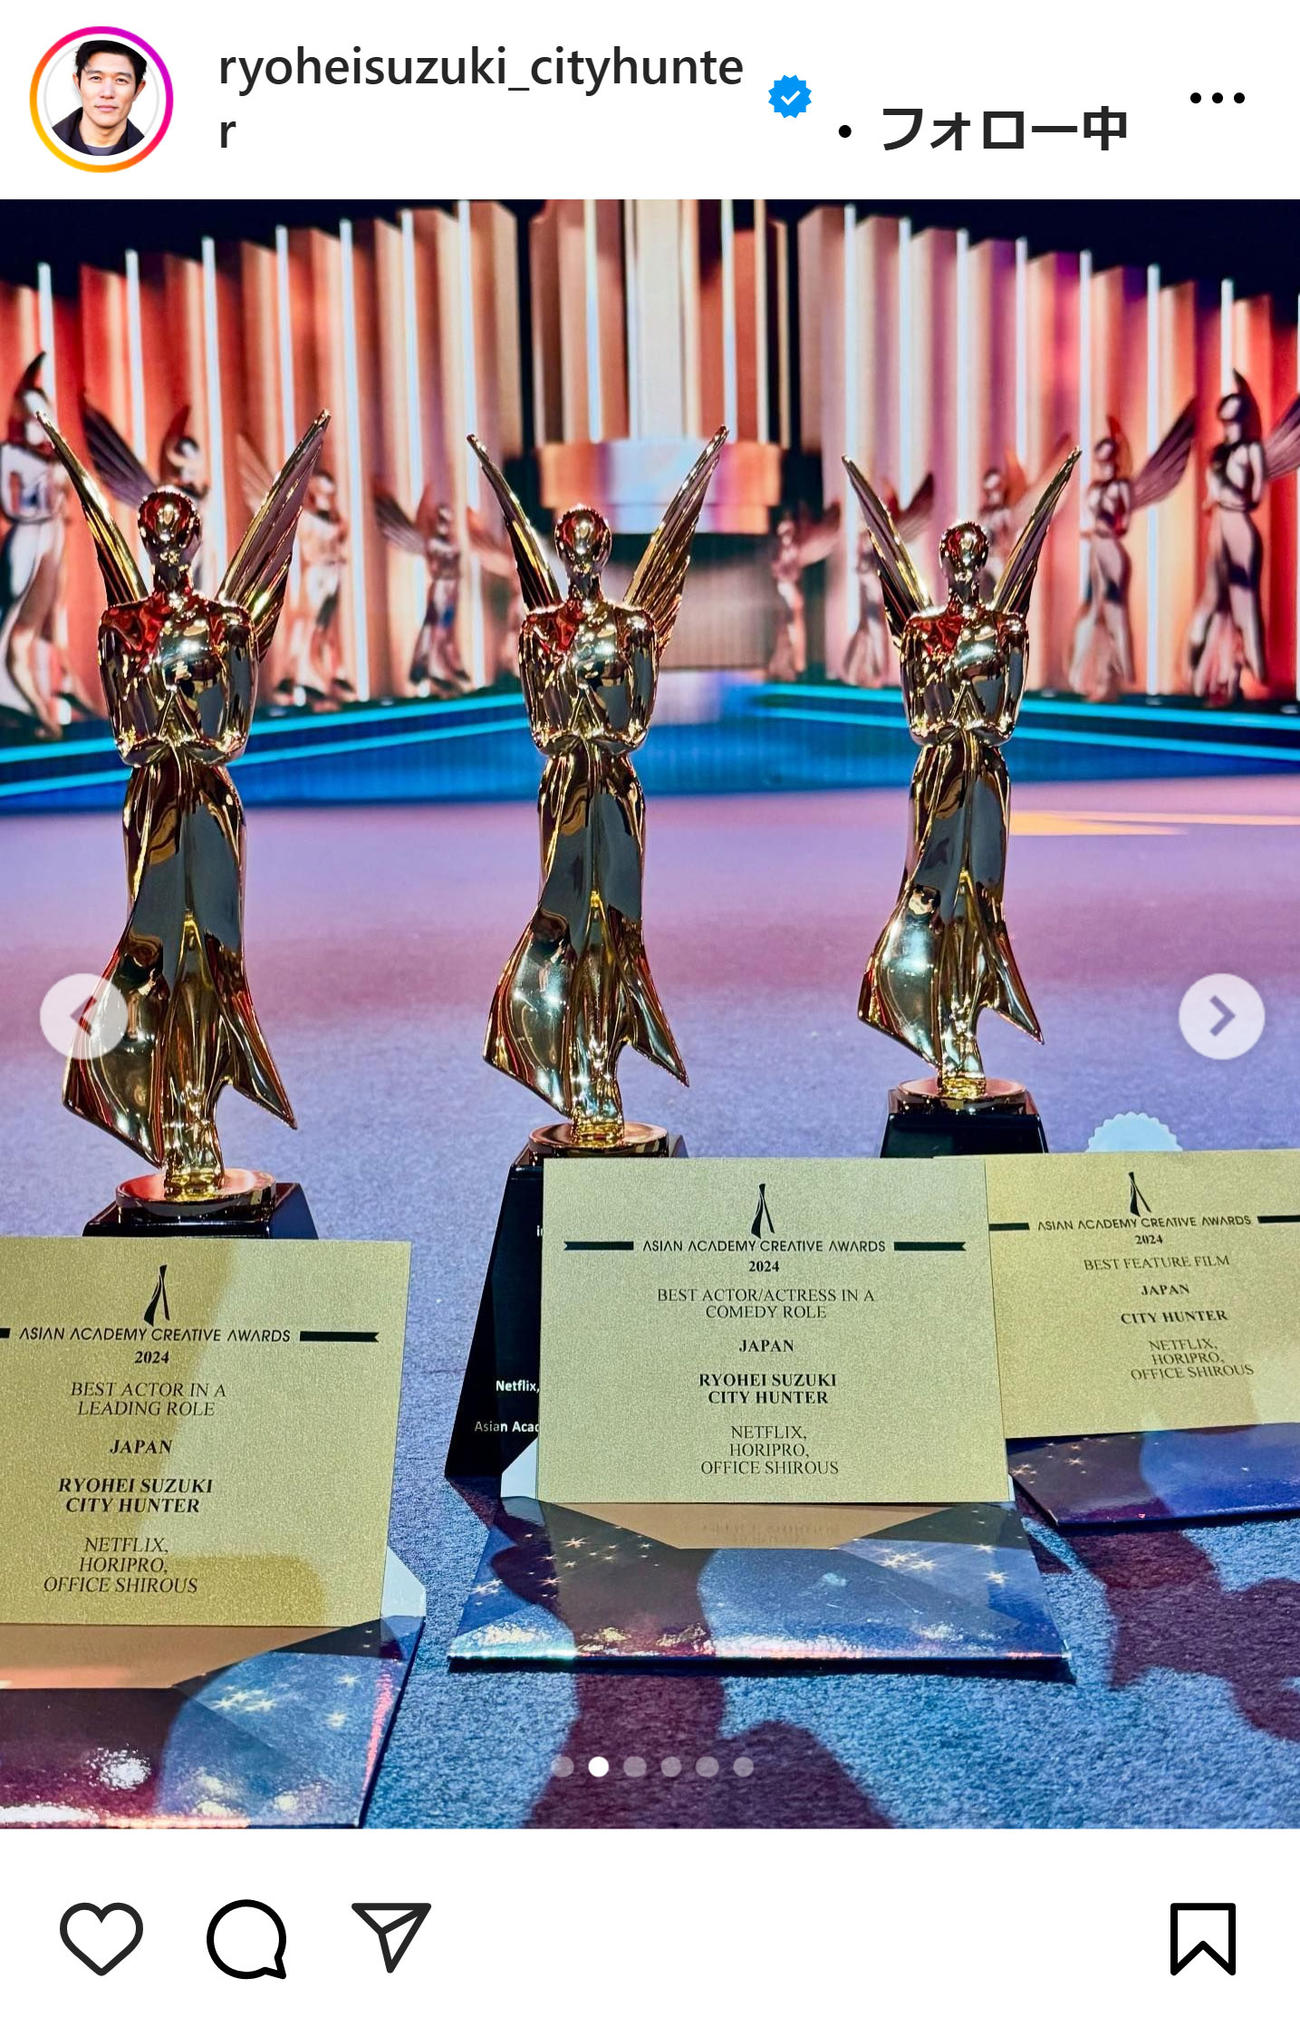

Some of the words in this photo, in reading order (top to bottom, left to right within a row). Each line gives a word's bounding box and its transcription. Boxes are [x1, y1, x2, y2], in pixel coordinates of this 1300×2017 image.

[1037, 1220, 1074, 1232] ASIAN
[1077, 1218, 1138, 1231] ACADEMY
[1140, 1216, 1197, 1229] CREATIVE
[1201, 1215, 1251, 1227] AWARDS
[642, 1240, 683, 1252] ASIAN
[688, 1240, 756, 1252] ACADEMY
[759, 1240, 823, 1252] CREATIVE
[828, 1240, 886, 1253] AWARDS
[1135, 1234, 1164, 1245] 2024
[749, 1260, 780, 1273] 2024
[1083, 1258, 1120, 1271] BEST
[1123, 1256, 1192, 1270] FEATURE
[1194, 1255, 1230, 1267] FILM
[658, 1288, 698, 1302] BEST
[702, 1288, 837, 1302] ACTOR/ACTRESS
[842, 1289, 858, 1302] IN
[863, 1290, 875, 1302] A
[1141, 1283, 1190, 1296] JAPAN
[705, 1305, 777, 1319] COMEDY
[783, 1305, 827, 1319] ROLE
[1120, 1312, 1158, 1325] CITY
[1162, 1310, 1229, 1323] HUNTER
[18, 1326, 65, 1341] ASIAN
[69, 1327, 148, 1341] ACADEMY
[151, 1328, 221, 1342] CREATIVE
[227, 1329, 291, 1343] AWARDS
[739, 1339, 794, 1353] JAPAN
[1148, 1338, 1219, 1351] NETFLIX,
[134, 1350, 169, 1364] 2024
[1151, 1352, 1225, 1366] HORIPRO,
[699, 1373, 766, 1387] RYOHEI
[771, 1373, 836, 1387] SUZUKI
[1130, 1367, 1185, 1381] OFFICE
[1187, 1364, 1255, 1378] SHIROUS
[71, 1381, 117, 1397] BEST
[121, 1382, 184, 1397] ACTOR
[190, 1382, 209, 1397] IN
[214, 1384, 226, 1397] A
[495, 1379, 540, 1394] Netflix,
[708, 1390, 749, 1404] CITY
[756, 1391, 828, 1404] HUNTER
[78, 1400, 161, 1416] LEADING
[166, 1401, 214, 1416] ROLE
[474, 1420, 508, 1433] Asian
[731, 1425, 807, 1439] NETFLIX,
[109, 1439, 172, 1455] JAPAN
[730, 1443, 809, 1458] HORIPRO,
[700, 1460, 760, 1475] OFFICE
[765, 1461, 839, 1475] SHIROUS
[59, 1477, 135, 1493] RYOHEI
[139, 1478, 213, 1494] SUZUKI
[65, 1497, 114, 1513] CITY
[118, 1497, 200, 1513] HUNTER
[85, 1537, 168, 1553] NETFLIX,
[79, 1557, 168, 1573] HORIPRO,
[43, 1576, 111, 1593] OFFICE
[115, 1577, 198, 1594] SHIROUS
